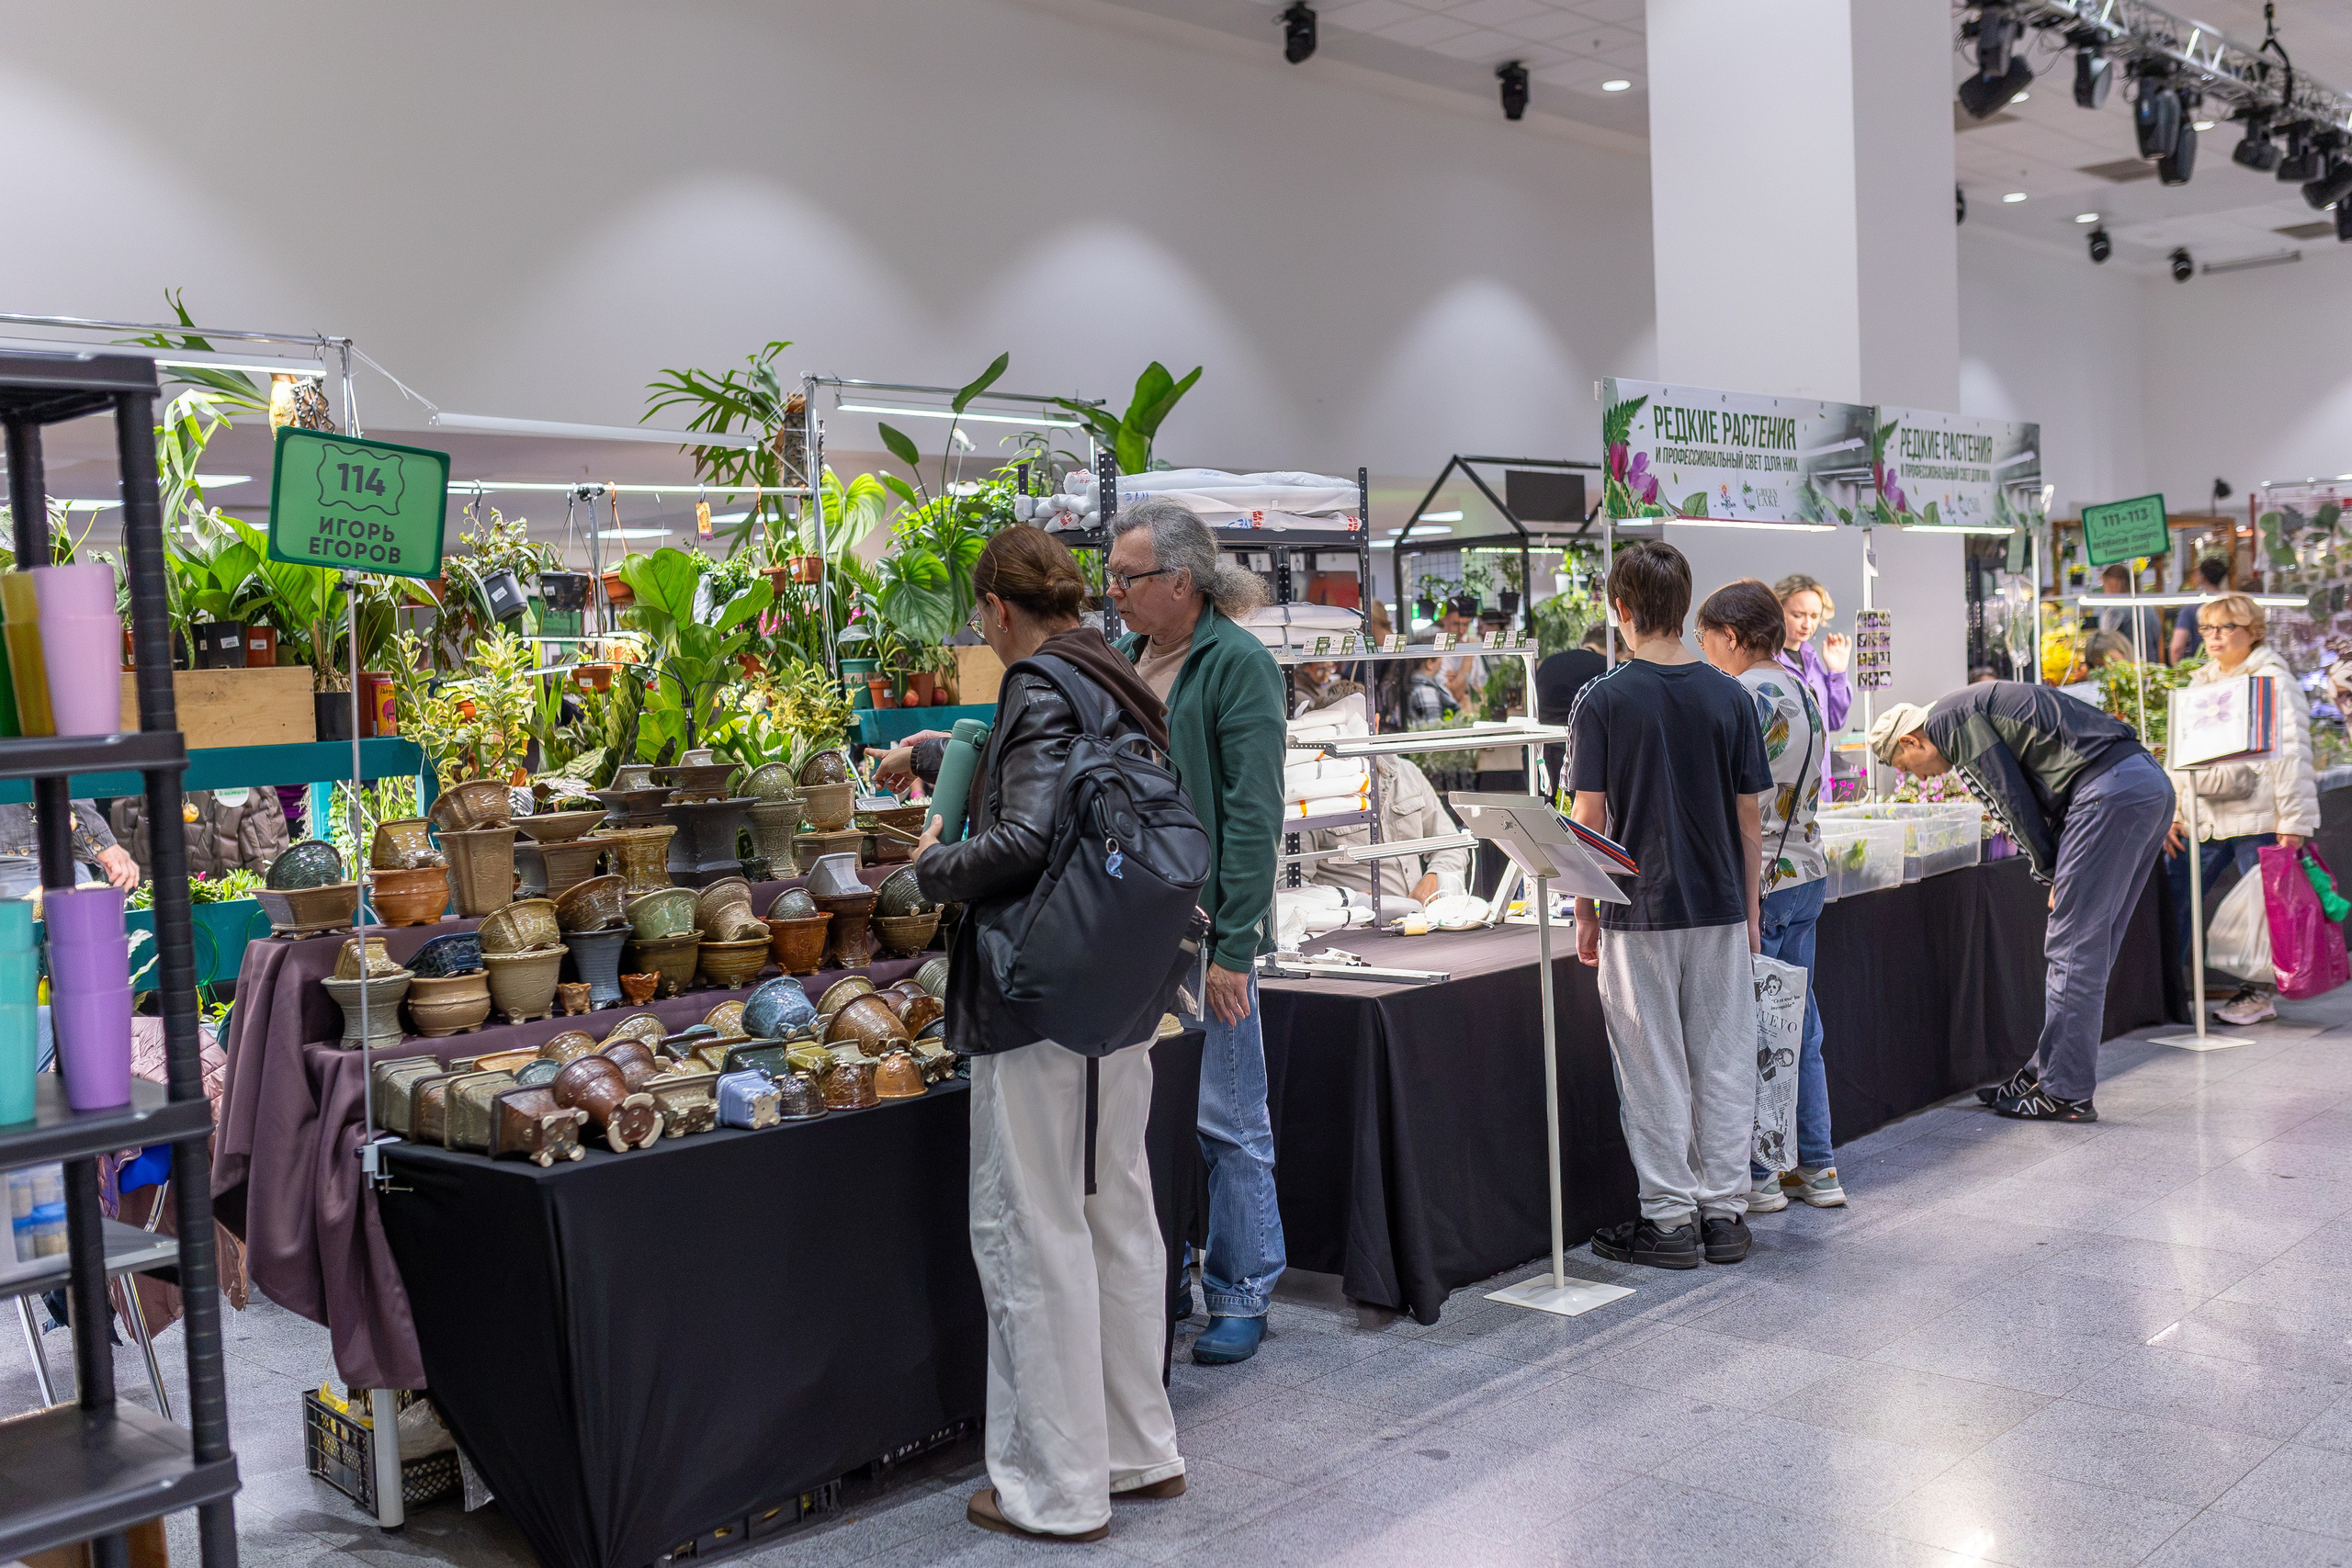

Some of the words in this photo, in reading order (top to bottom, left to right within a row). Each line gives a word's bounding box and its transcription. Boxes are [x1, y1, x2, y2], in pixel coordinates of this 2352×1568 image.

[1653, 405, 1719, 446] РЕДКИЕ
[1722, 412, 1797, 451] РАСТЕНИЯ
[1656, 446, 1661, 463] И
[1663, 447, 1744, 469] ПРОФЕССИОНАЛЬНЫЙ
[1745, 455, 1762, 470] СВЕТ
[1764, 457, 1781, 472] ДЛЯ
[1783, 457, 1798, 473] НИХ
[1900, 427, 1941, 462] РЕДКИЕ
[1942, 432, 1993, 465] РАСТЕНИЯ
[336, 463, 386, 497] 114
[319, 516, 395, 543] ИГОРЬ
[2101, 507, 2148, 527] 111-113
[309, 536, 401, 564] ЕГОРОВ
